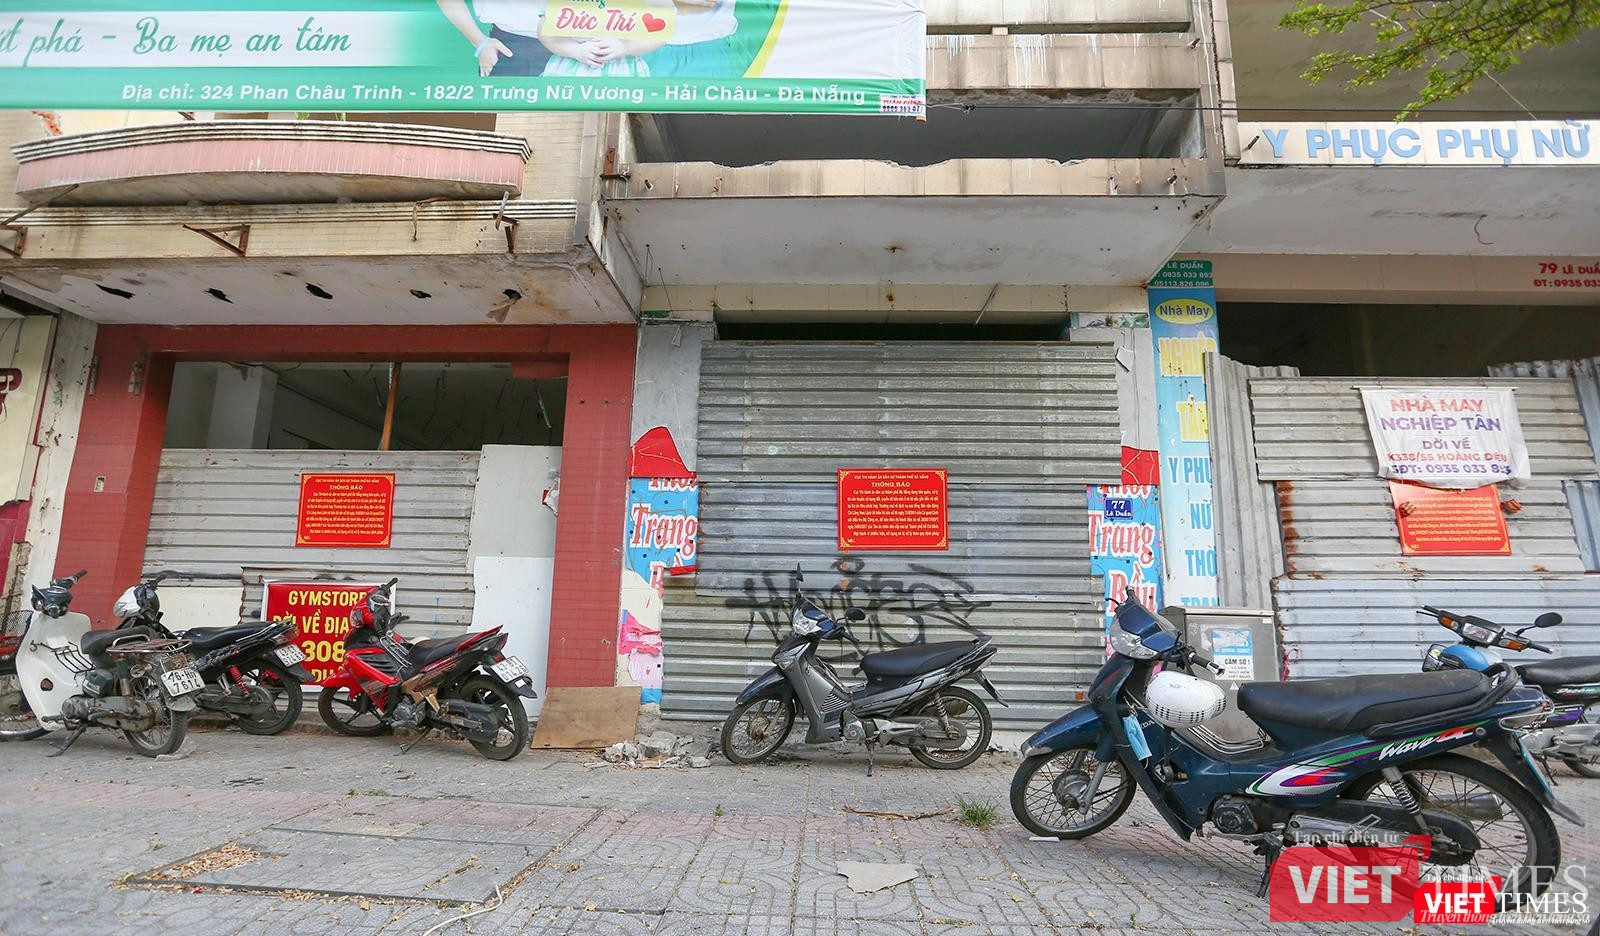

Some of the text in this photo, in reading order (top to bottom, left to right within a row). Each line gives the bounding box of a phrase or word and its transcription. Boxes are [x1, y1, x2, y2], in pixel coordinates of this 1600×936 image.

[556, 7, 638, 32] Đức Trí
[22, 17, 84, 68] phá
[133, 16, 178, 55] Ba
[190, 33, 232, 58] mẹ
[246, 34, 283, 52] an
[296, 16, 352, 52] tâm
[122, 84, 153, 102] Địa
[159, 83, 195, 100] chỉ:
[200, 85, 233, 100] 324
[240, 85, 289, 100] Phan
[295, 84, 346, 100] Châu
[352, 85, 402, 100] Trinh
[424, 84, 474, 100] 182/2
[481, 84, 538, 104] Trưng
[545, 84, 575, 100] Nữ
[580, 84, 645, 104] Vương
[665, 83, 697, 100] Hải
[704, 84, 757, 101] Châu
[778, 85, 805, 101] Đà
[812, 84, 865, 105] Nẵng
[1262, 119, 1590, 167] Y PHỤC PHỤ NỮ
[1538, 262, 1558, 274] 79
[1554, 279, 1582, 287] 0935
[1160, 304, 1209, 318] Nhà May
[1391, 395, 1483, 412] NHÀ MAY
[1380, 414, 1501, 434] NGHIỆP TÂN
[1423, 437, 1471, 450] DỜI VỀ
[1437, 452, 1480, 461] HOÀNG
[1168, 457, 1178, 483] Y
[1391, 464, 1423, 474] SĐT:
[1425, 464, 1459, 473] 0935
[1463, 464, 1487, 473] 033
[1111, 500, 1125, 510] 77
[632, 506, 697, 557] Trang
[1089, 512, 1154, 564] Trang
[302, 609, 321, 634] VỀ
[325, 616, 350, 637] ĐỊA
[302, 641, 345, 662] 308
[1379, 736, 1439, 760] Wave
